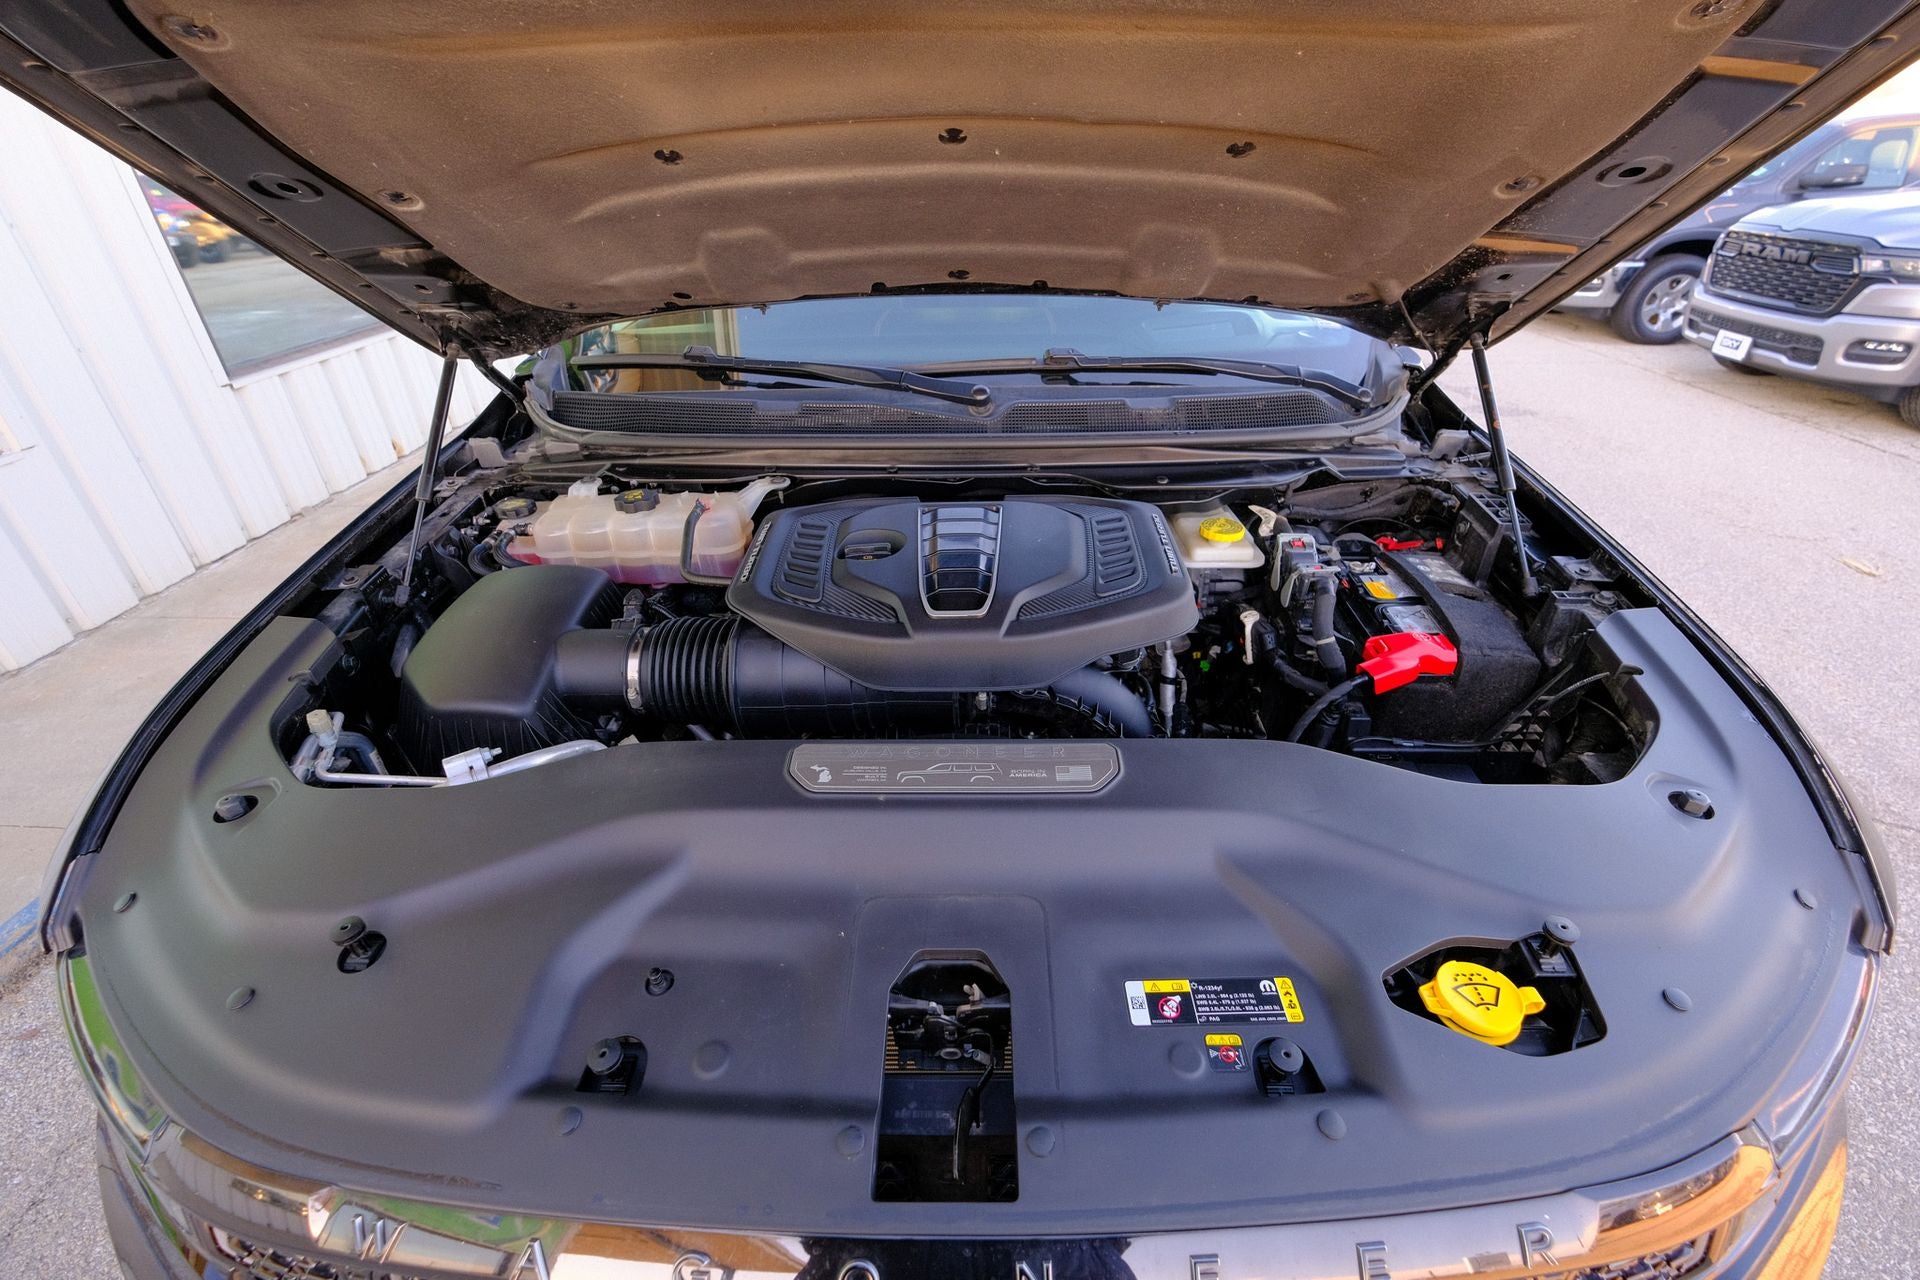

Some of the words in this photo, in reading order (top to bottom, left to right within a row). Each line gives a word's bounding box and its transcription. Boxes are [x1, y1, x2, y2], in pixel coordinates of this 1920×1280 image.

[1742, 241, 1811, 264] RAM
[1152, 513, 1169, 545] TURBO
[741, 545, 760, 583] TURBO
[848, 746, 1065, 758] WAGONEER
